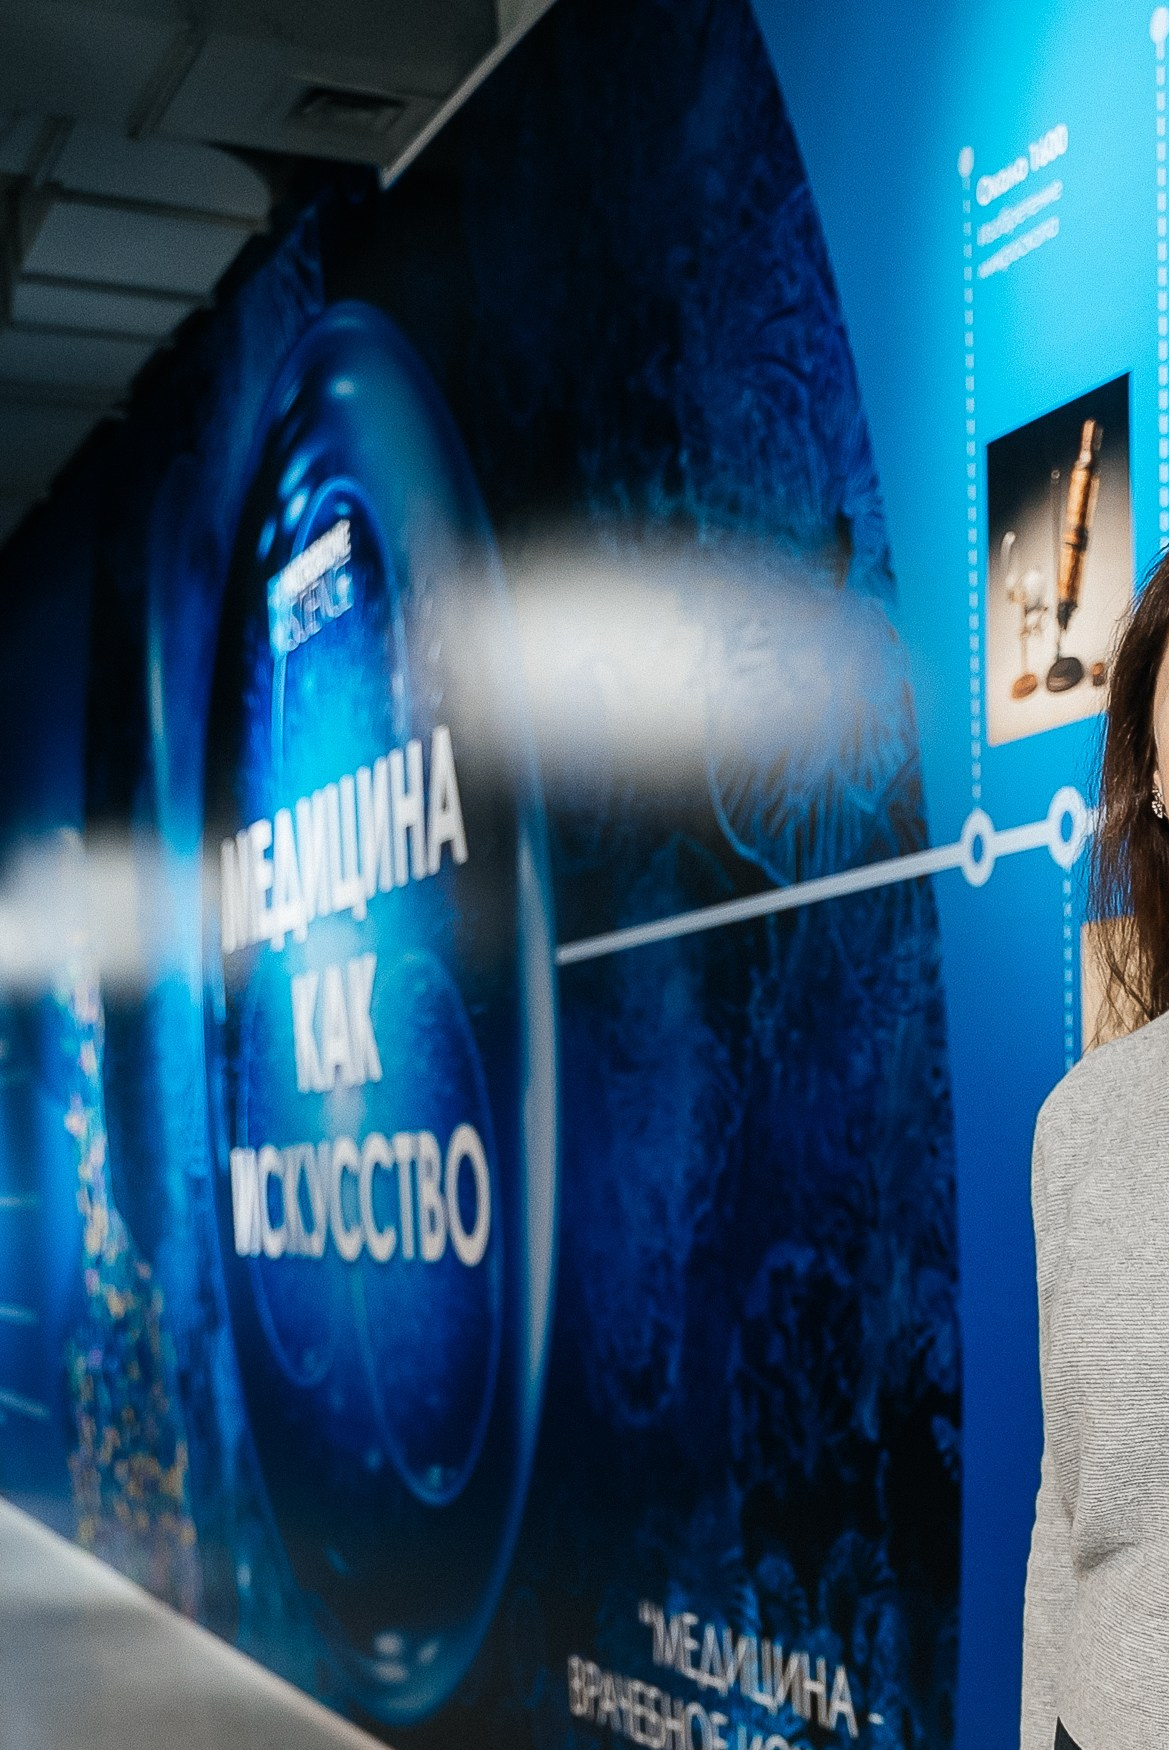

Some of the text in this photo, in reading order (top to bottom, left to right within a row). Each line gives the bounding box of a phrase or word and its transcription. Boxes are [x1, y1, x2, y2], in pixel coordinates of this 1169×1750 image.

[220, 724, 469, 953] МЕДИЦИНА
[290, 952, 383, 1093] КАК
[229, 1122, 492, 1268] ИСКУССТВО
[638, 1600, 859, 1738] "МЕДИЦИНА
